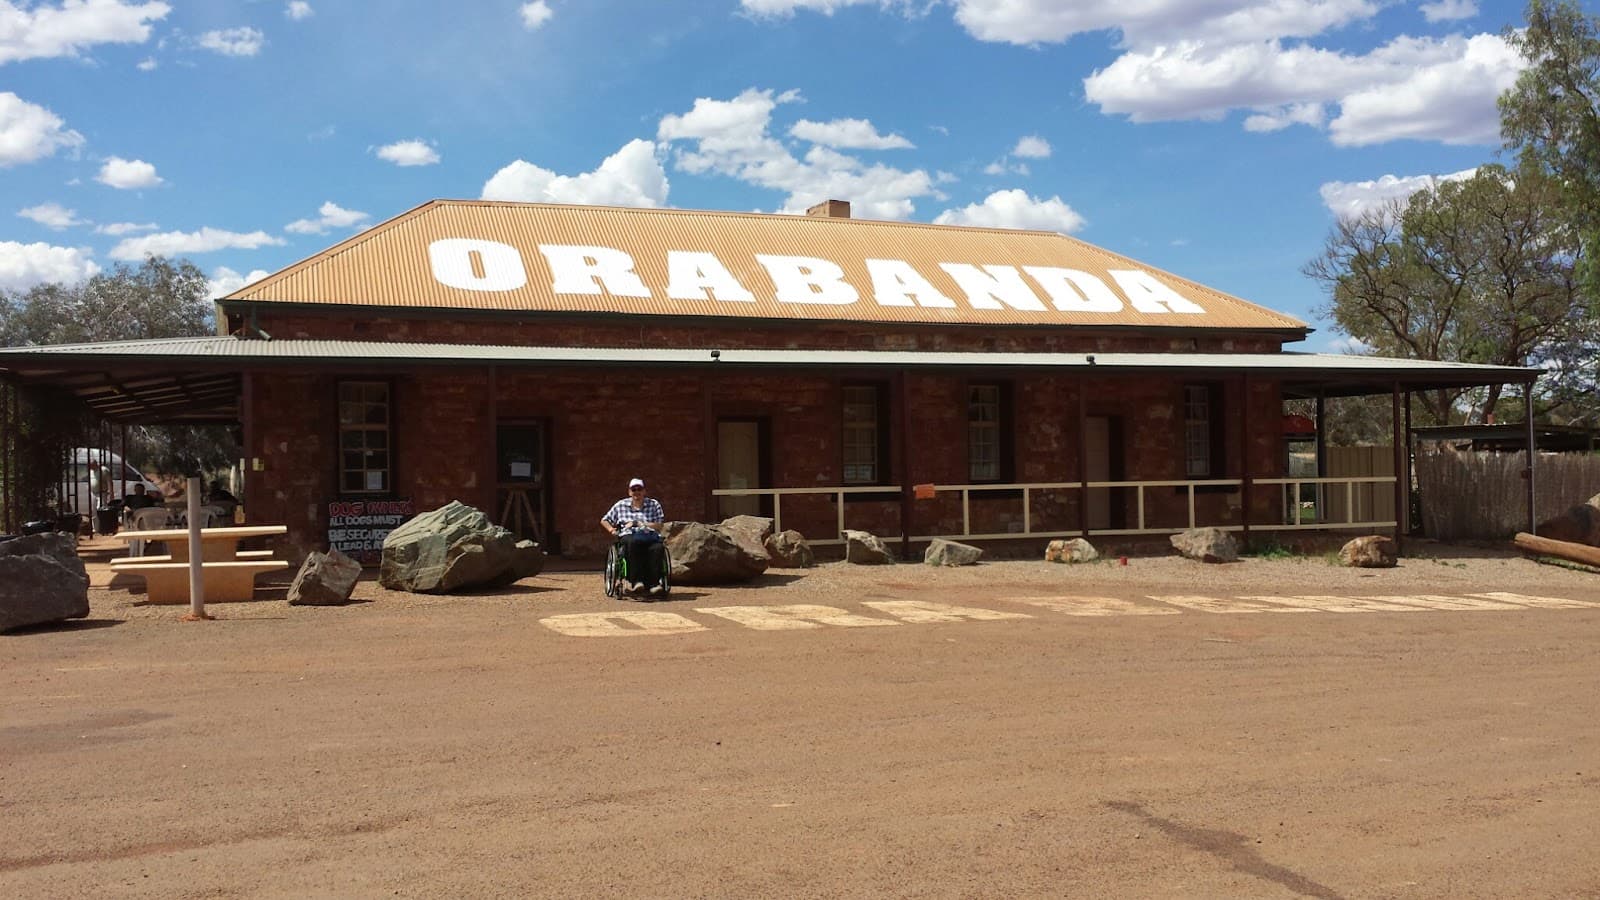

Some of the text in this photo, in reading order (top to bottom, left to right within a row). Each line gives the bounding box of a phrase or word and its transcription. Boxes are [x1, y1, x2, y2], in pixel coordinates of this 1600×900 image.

[428, 237, 1207, 314] ORABANDA
[328, 502, 364, 516] DOG
[330, 515, 403, 526] ALL DOGS MUST
[328, 529, 391, 541] BE SECURE
[339, 541, 363, 551] LEAD
